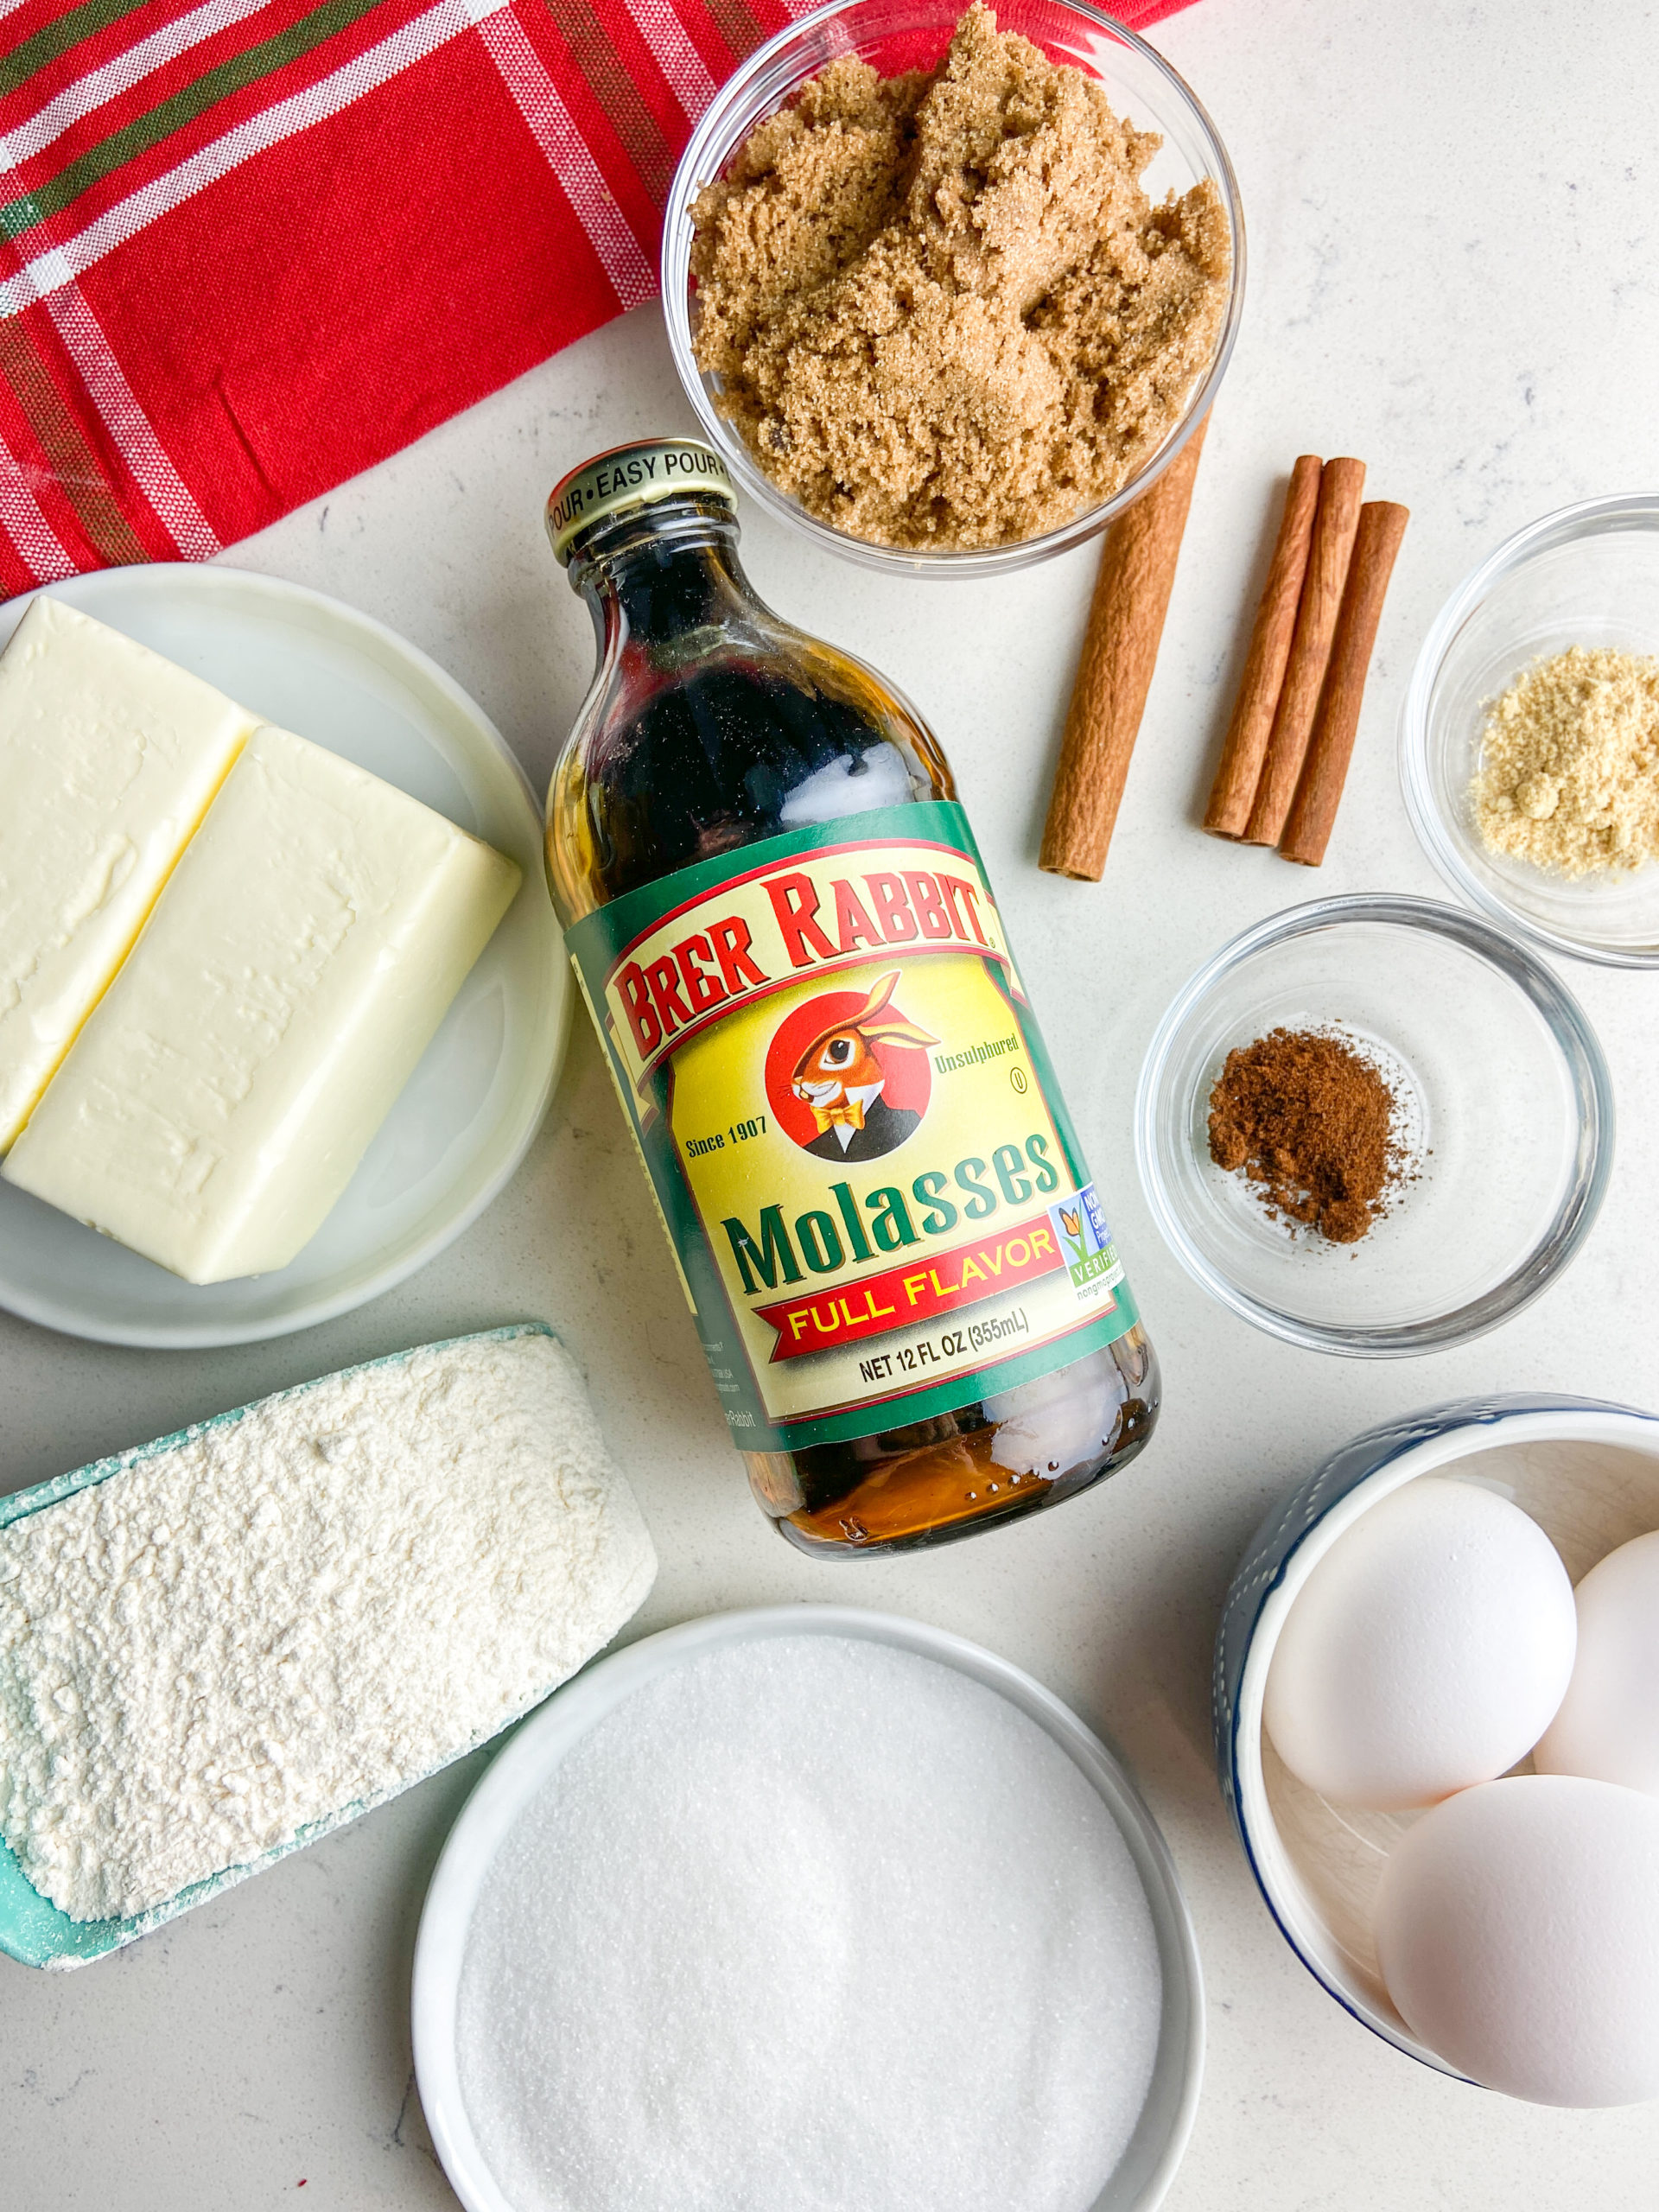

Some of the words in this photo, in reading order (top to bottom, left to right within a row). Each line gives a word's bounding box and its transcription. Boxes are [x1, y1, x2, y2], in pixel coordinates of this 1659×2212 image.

[596, 456, 656, 499] EASY
[664, 452, 720, 476] POUR
[613, 915, 772, 1062] BRER
[760, 871, 990, 969] RABBIT
[934, 1033, 1020, 1074] Unsulphured
[685, 1134, 725, 1158] Since
[728, 1116, 766, 1144] 1907
[720, 1134, 1060, 1295] Molasses
[787, 1290, 895, 1340] FULL
[902, 1229, 1055, 1306] FLAVOR
[859, 1354, 893, 1382] NET
[896, 1348, 918, 1371] 12
[917, 1342, 941, 1365] FL
[941, 1331, 968, 1357] OZ
[968, 1307, 1029, 1352] (355mL)
